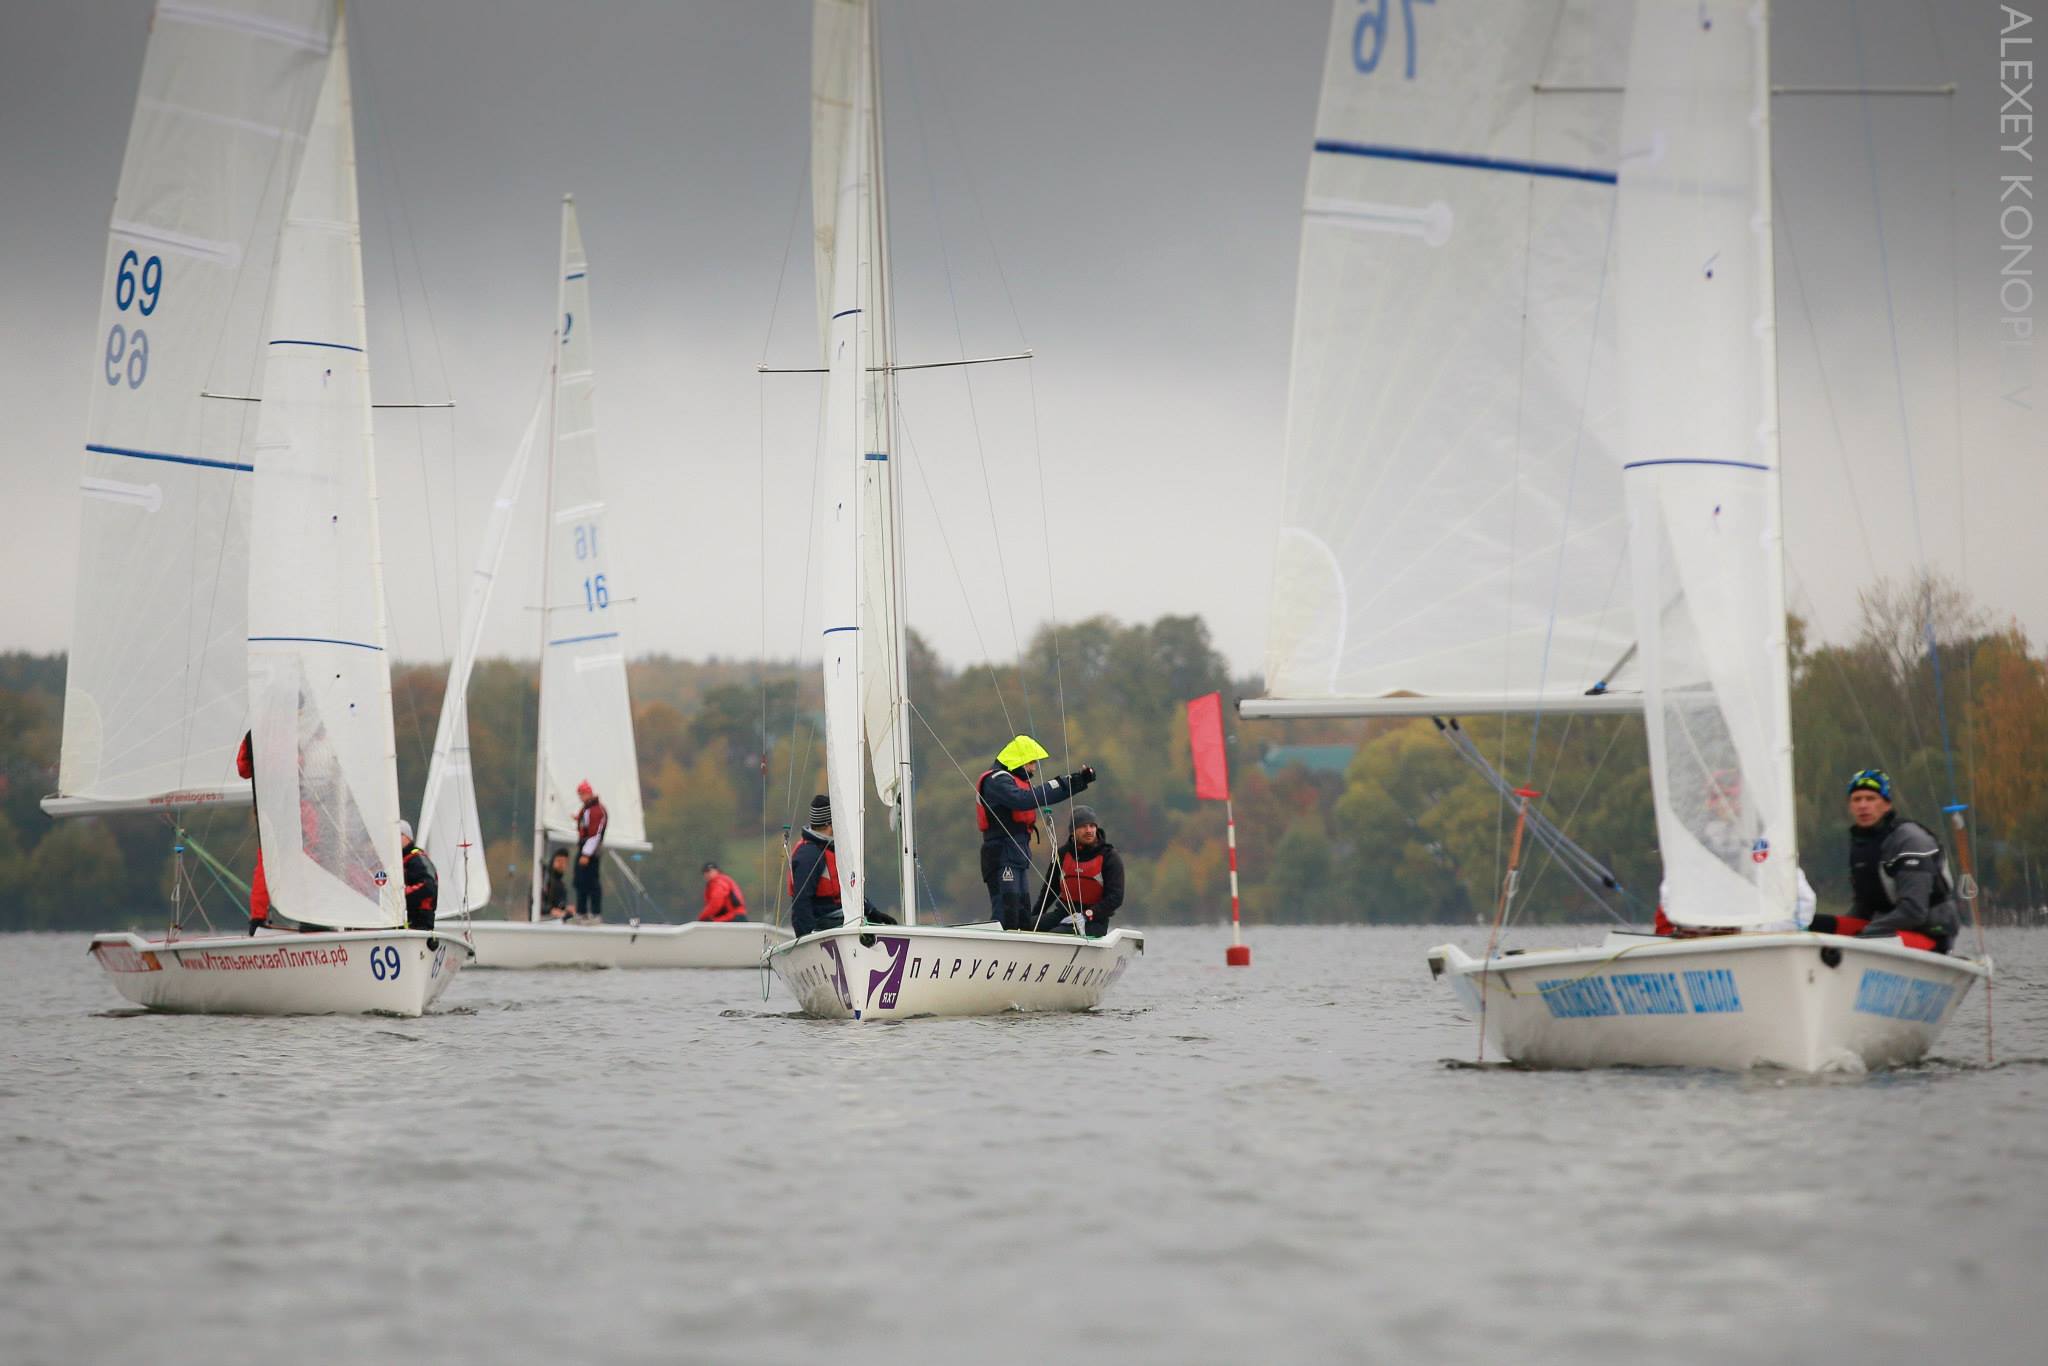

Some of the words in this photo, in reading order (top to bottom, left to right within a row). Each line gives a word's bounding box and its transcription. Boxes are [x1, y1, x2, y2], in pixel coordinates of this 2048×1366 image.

[116, 249, 162, 316] 69
[584, 574, 608, 612] 16
[370, 945, 401, 981] 69
[909, 957, 1050, 983] ПАРУСНАЯ
[881, 992, 897, 1004] ЯХТ
